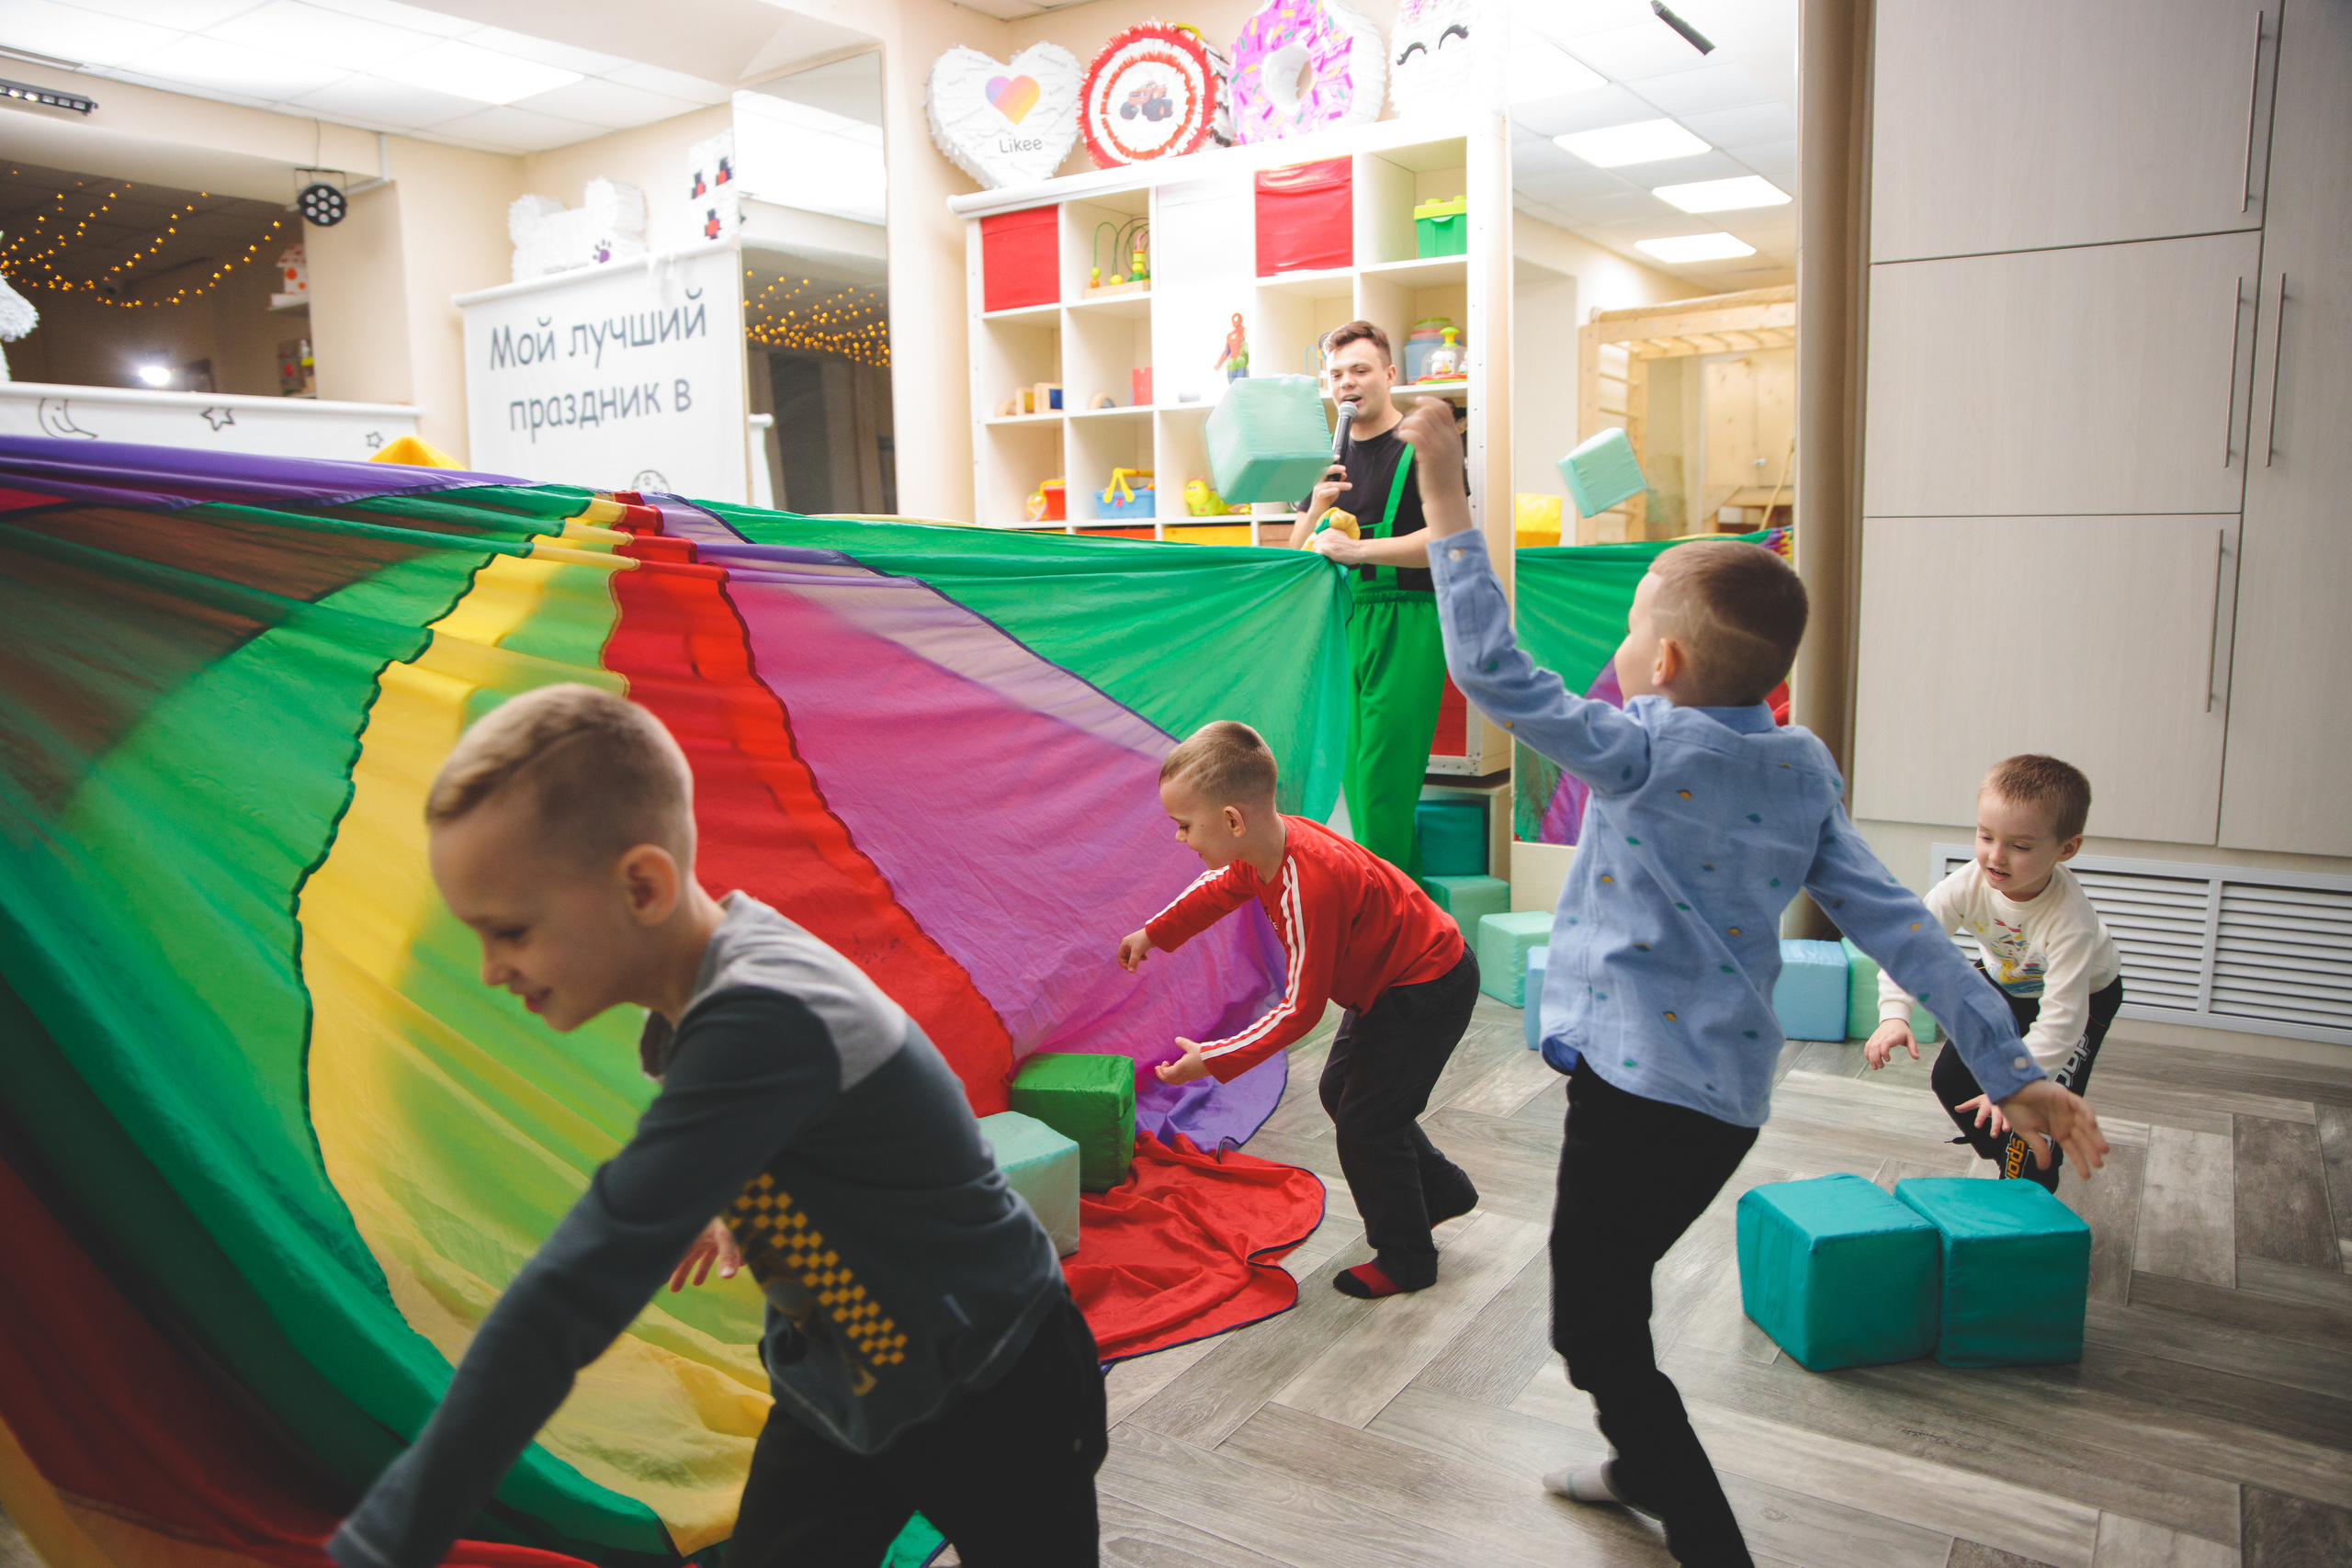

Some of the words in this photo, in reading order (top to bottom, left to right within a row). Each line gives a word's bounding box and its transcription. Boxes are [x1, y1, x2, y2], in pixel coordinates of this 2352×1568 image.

[1000, 138, 1043, 153] Likee
[491, 316, 555, 370] Мой
[568, 288, 707, 368] лучший
[509, 381, 662, 444] праздник
